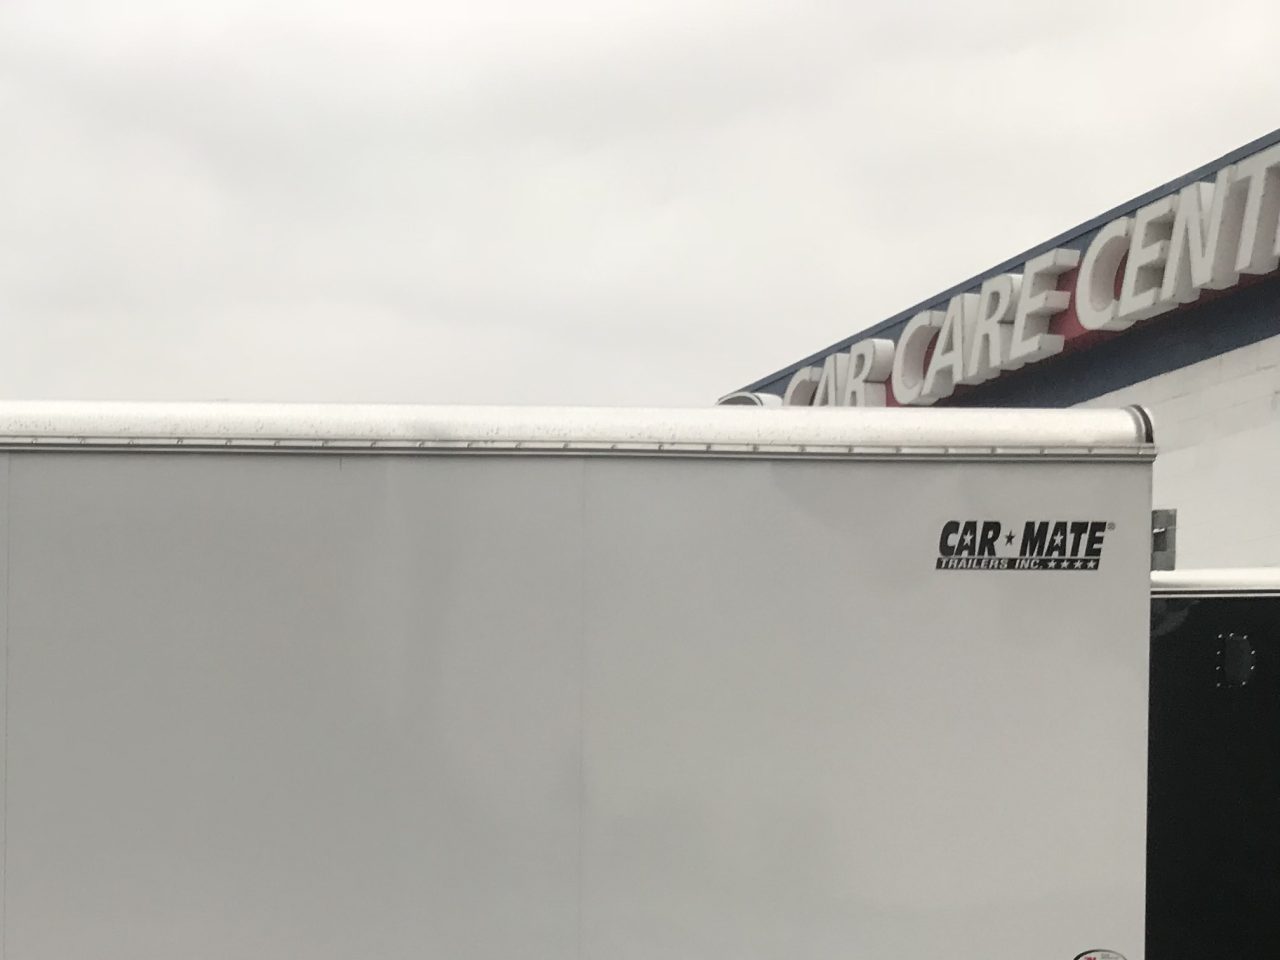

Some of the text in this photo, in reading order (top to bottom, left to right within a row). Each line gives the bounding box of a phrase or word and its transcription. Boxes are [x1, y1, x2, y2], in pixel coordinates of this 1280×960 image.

[891, 248, 1080, 406] CARE
[1076, 143, 1280, 331] CENT
[938, 520, 1001, 557] CAR
[940, 558, 1043, 570] TRAILERS INC.
